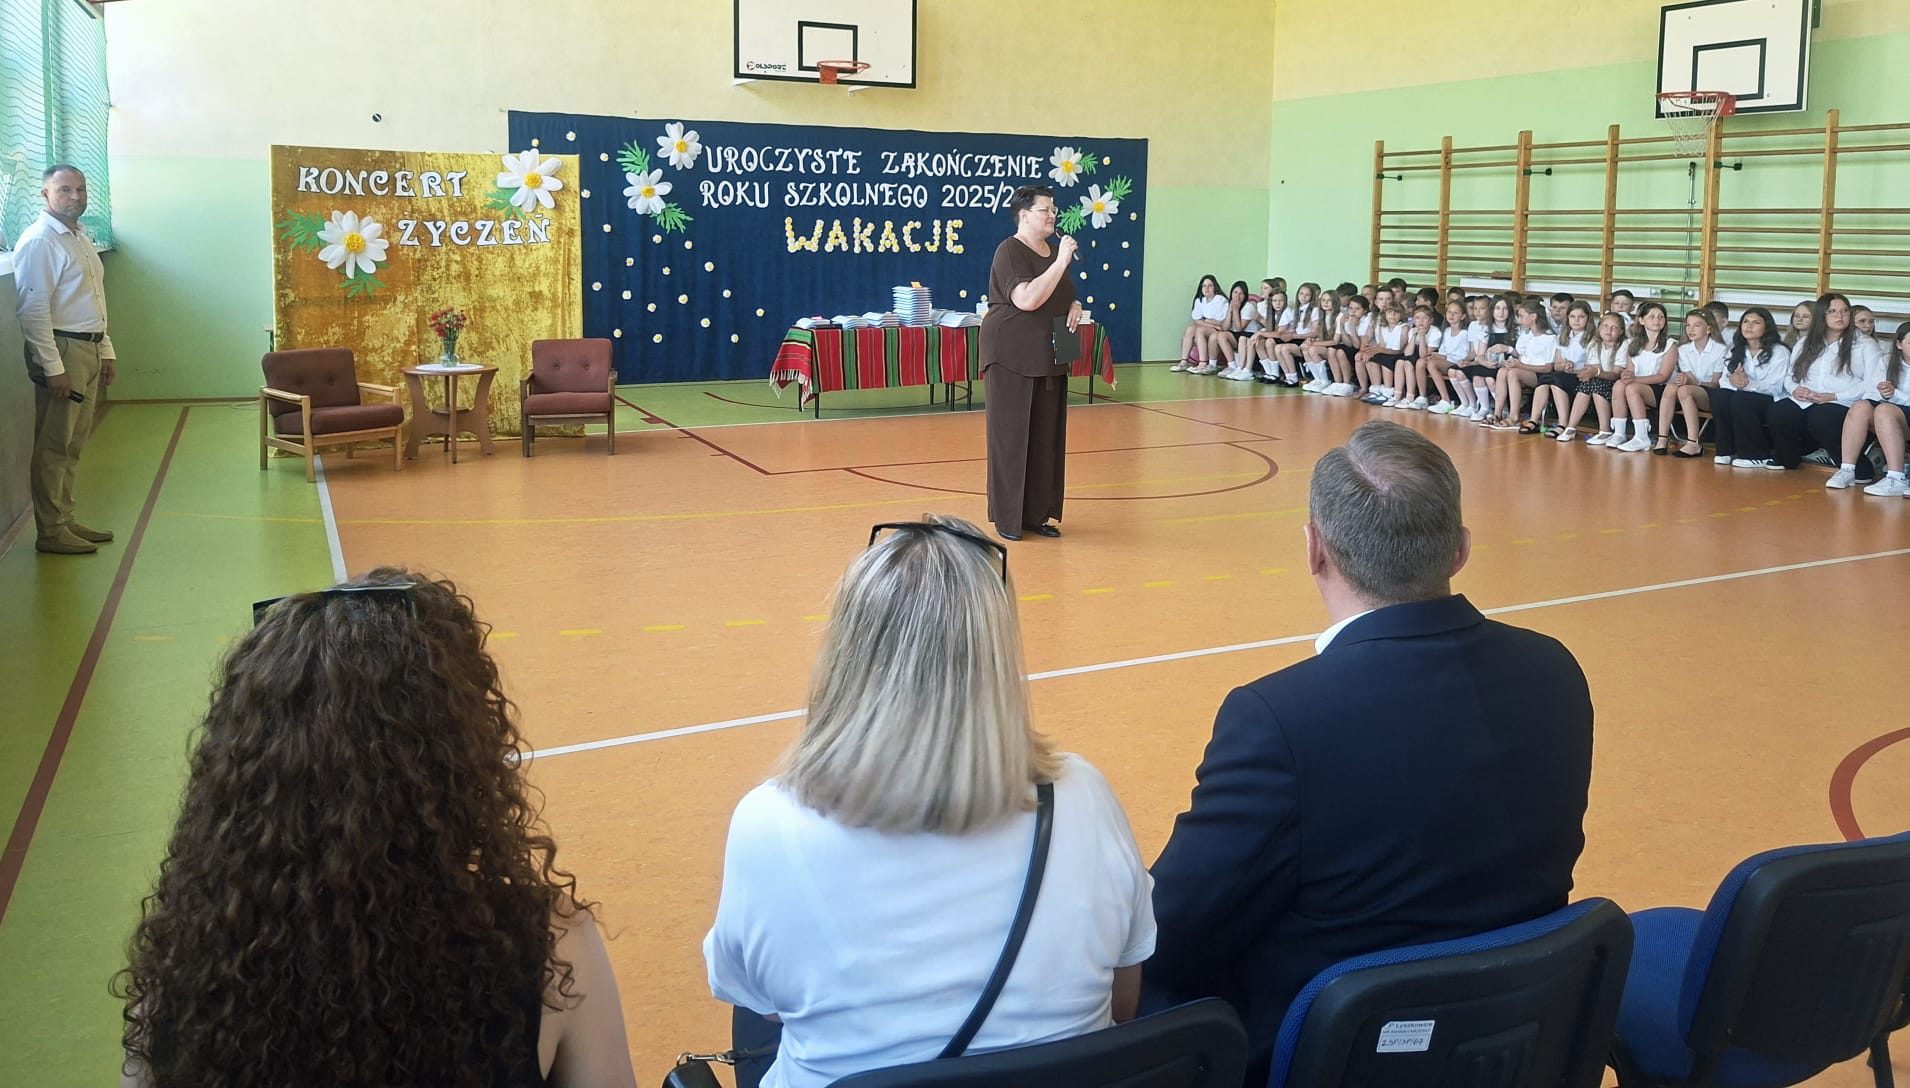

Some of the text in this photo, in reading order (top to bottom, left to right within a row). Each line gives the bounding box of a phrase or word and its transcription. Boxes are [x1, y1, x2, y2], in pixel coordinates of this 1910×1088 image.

[705, 146, 1044, 178] UROCZYSTE ZAKOŃCZENIE
[297, 166, 468, 198] KONCERT
[700, 180, 1054, 214] ROKU SZKOLNEGO 2025/2
[397, 211, 551, 247] ŻYCZEŃ
[785, 216, 964, 254] WAKACJE
